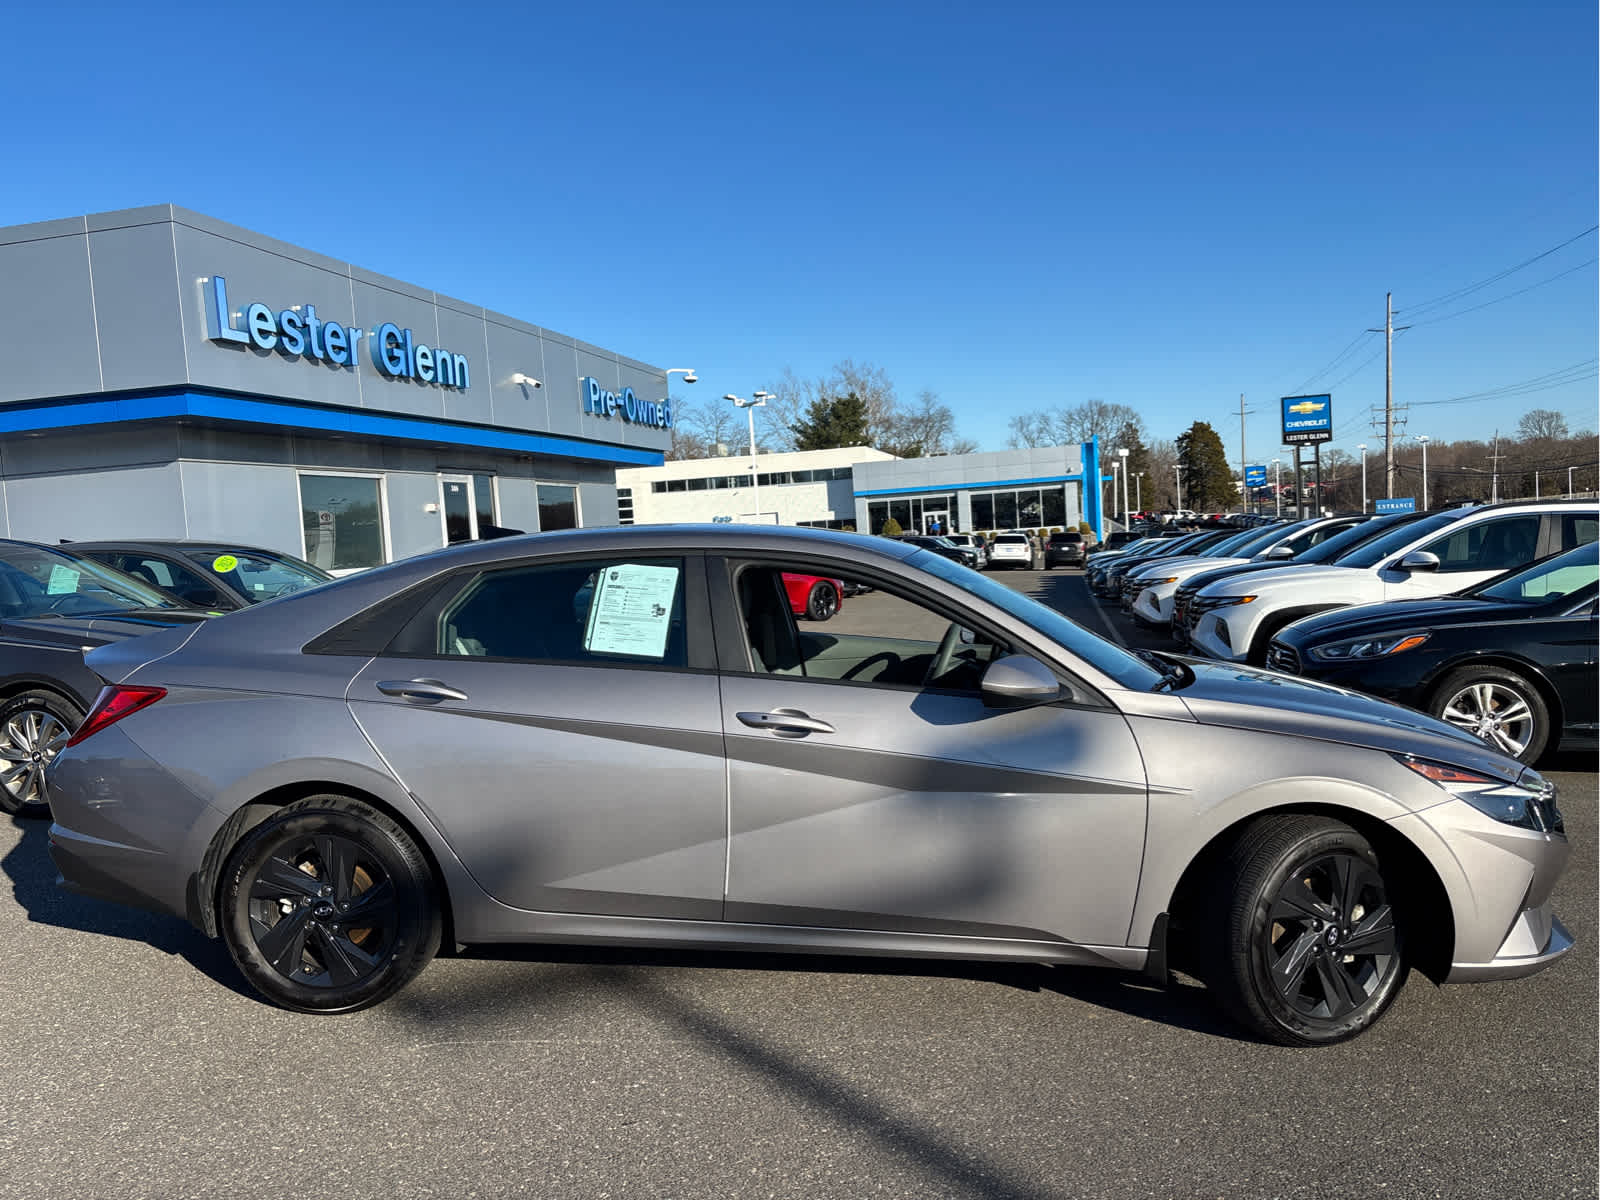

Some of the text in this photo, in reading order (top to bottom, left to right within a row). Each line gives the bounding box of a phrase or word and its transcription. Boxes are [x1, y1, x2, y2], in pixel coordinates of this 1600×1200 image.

[209, 276, 471, 389] Lester Glenn
[584, 376, 672, 429] Pre-Owned
[1286, 419, 1328, 428] CHEVROLET
[1376, 502, 1413, 510] ENTRANCE
